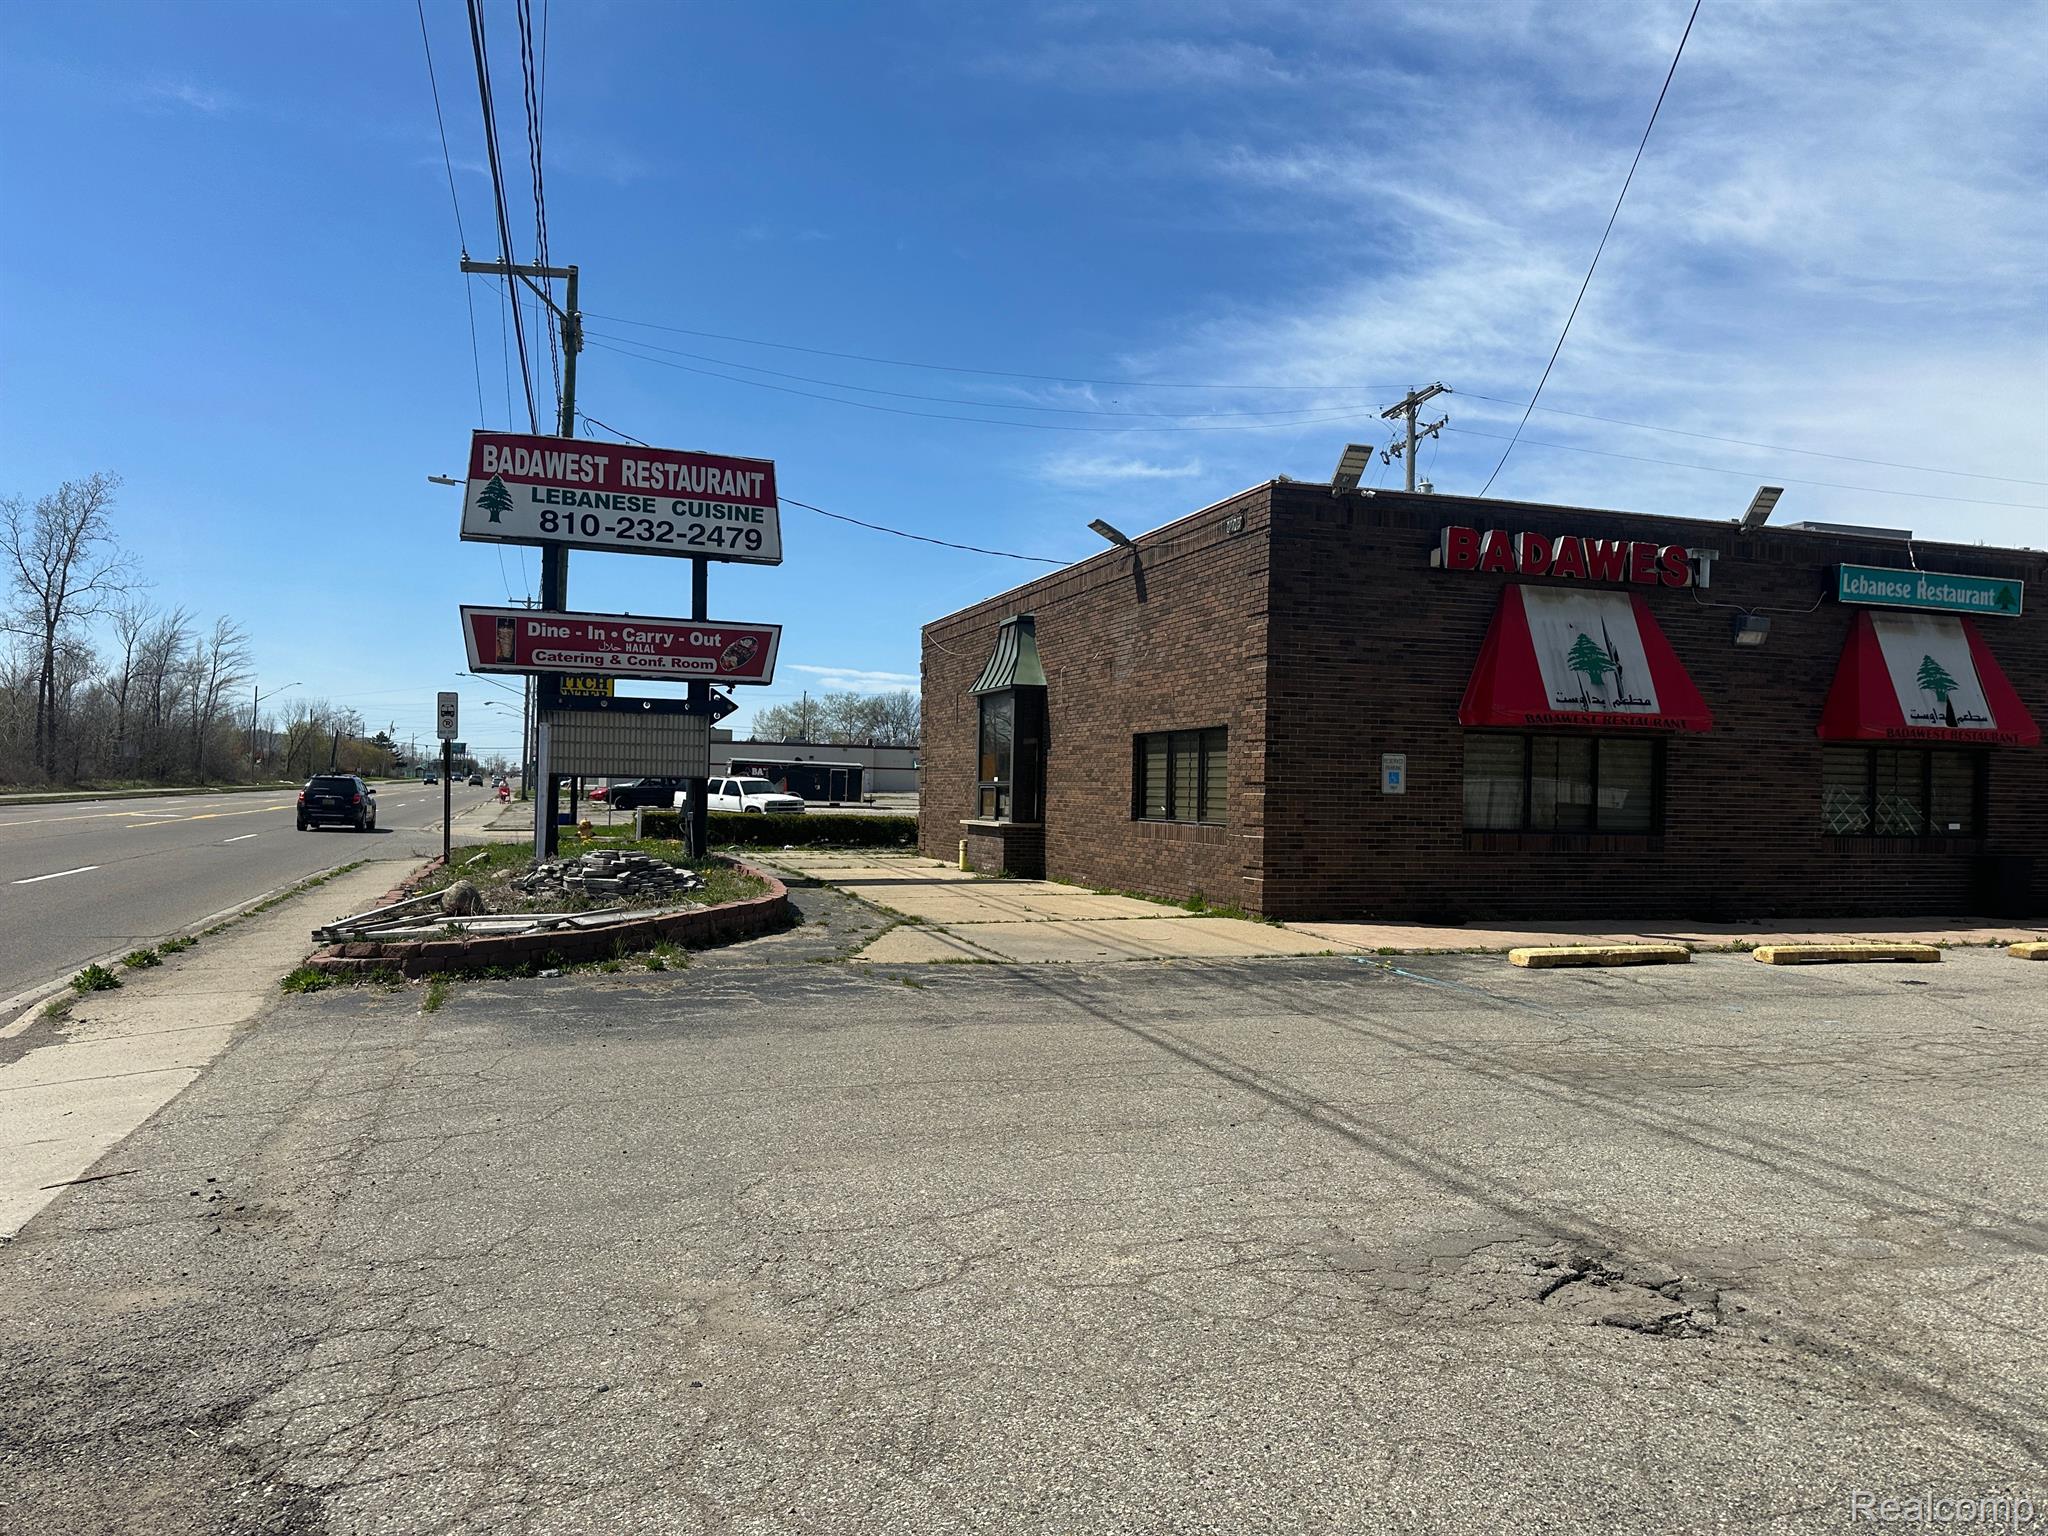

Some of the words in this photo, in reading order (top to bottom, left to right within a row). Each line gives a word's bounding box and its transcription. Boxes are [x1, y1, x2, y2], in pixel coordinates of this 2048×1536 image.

[482, 444, 608, 484] BADAWEST
[621, 459, 765, 499] RESTAURANT
[531, 486, 656, 514] LEBANESE
[671, 500, 764, 524] CUISINE
[539, 509, 762, 551] 810-232-2479
[1440, 525, 1719, 588] BADAWEST
[1842, 573, 1912, 599] Lebanese
[1917, 580, 1996, 606] Restaurant
[527, 621, 571, 638] Dine
[587, 625, 605, 641] In
[622, 626, 674, 648] Carry
[689, 632, 722, 648] Out
[535, 651, 605, 668] Catering
[609, 653, 621, 666] &
[627, 655, 666, 668] Conf.
[671, 658, 714, 671] Room
[625, 643, 656, 654] HALAL
[562, 676, 609, 690] ITCH
[1524, 713, 1599, 725] BADAWEST
[1602, 715, 1687, 729] RESTAURANT
[1886, 728, 1946, 740] BADAWEST
[1951, 729, 2020, 743] RESTAURANT
